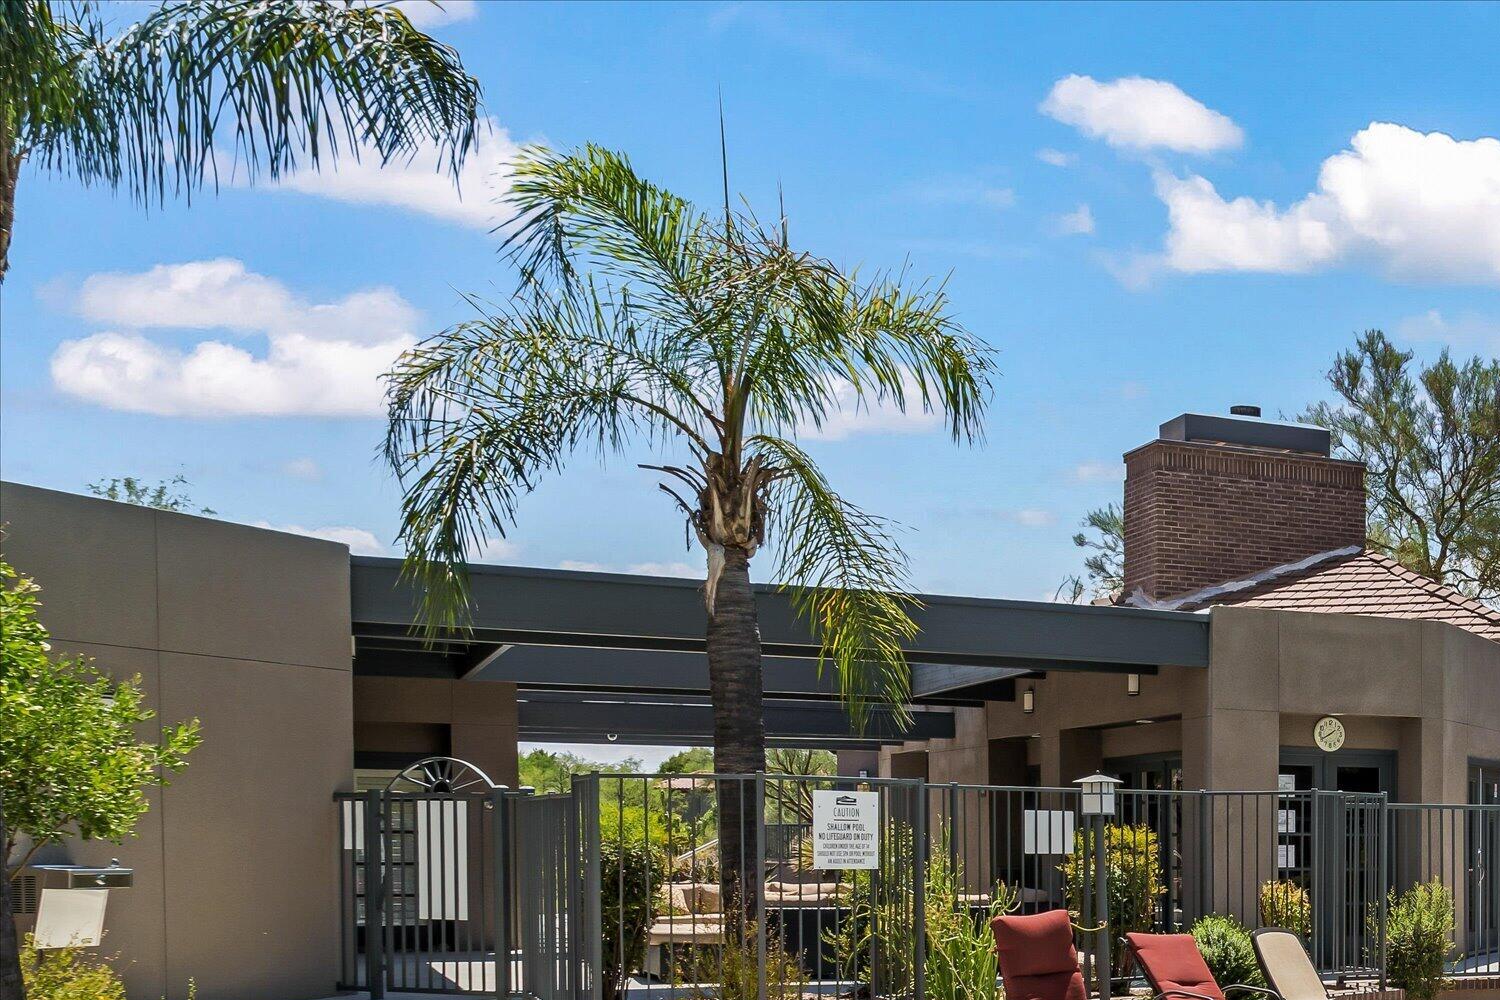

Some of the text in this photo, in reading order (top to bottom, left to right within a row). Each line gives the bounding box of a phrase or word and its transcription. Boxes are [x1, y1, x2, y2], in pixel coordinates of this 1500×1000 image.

[833, 807, 860, 817] CAUTION
[827, 823, 866, 831] SHALLOW POOL
[818, 832, 874, 841] NO LIFEGUARD ON DUTY
